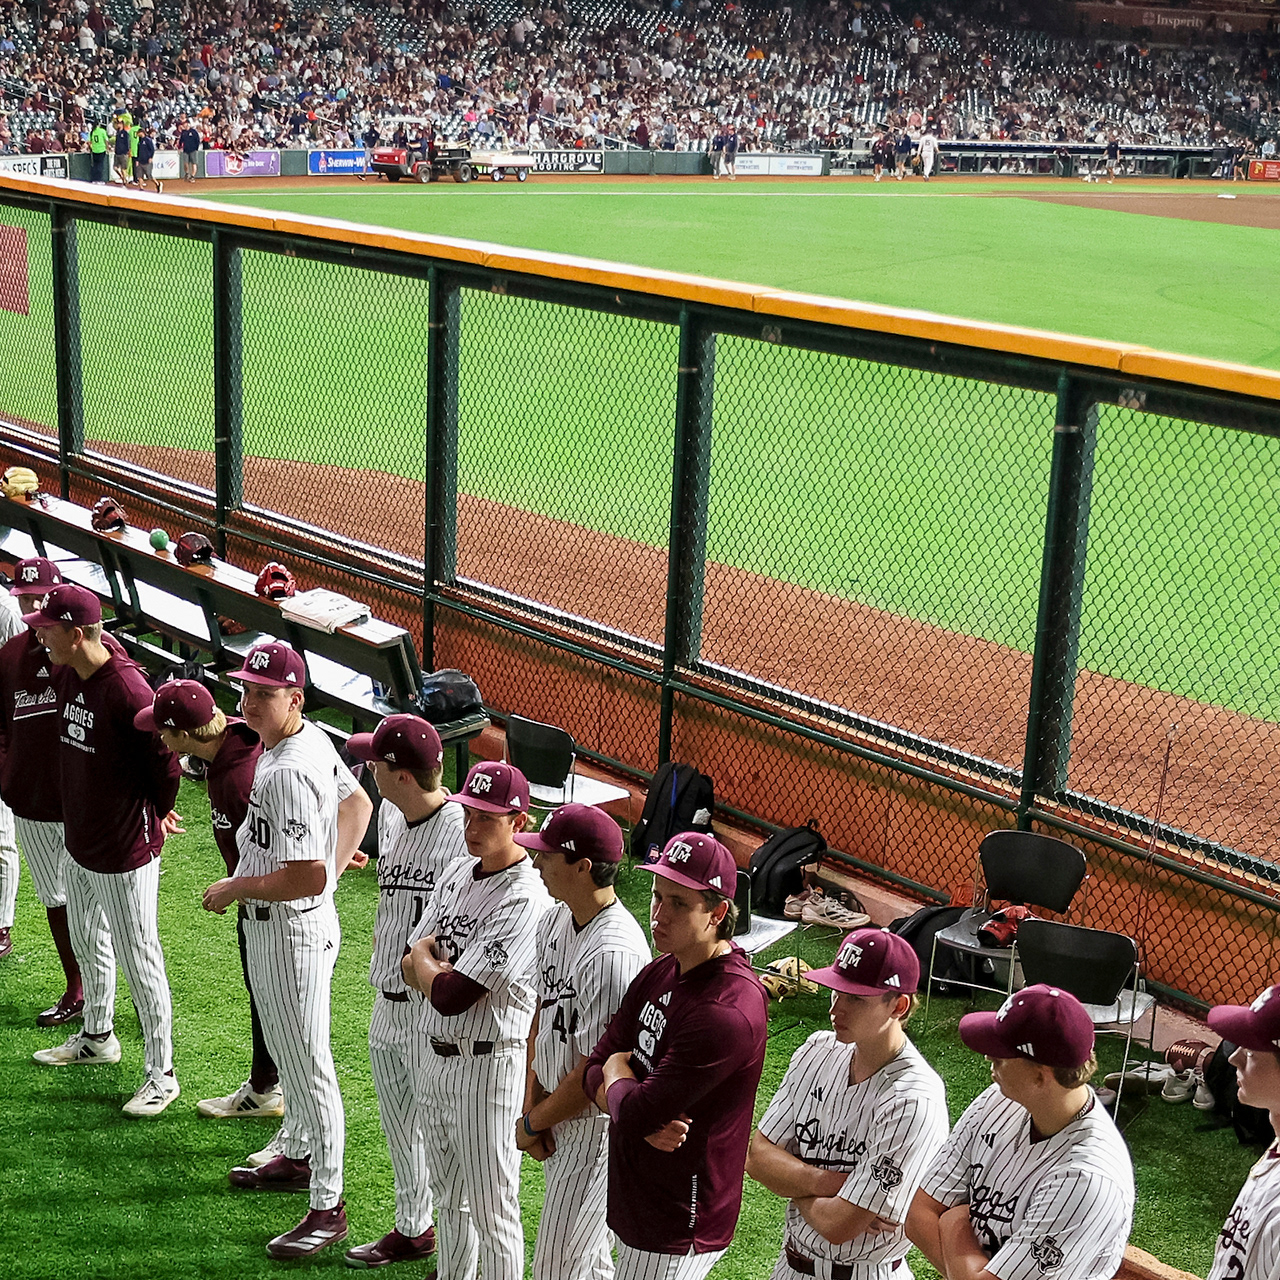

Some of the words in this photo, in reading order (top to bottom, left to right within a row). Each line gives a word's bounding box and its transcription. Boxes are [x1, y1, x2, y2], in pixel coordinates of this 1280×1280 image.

[533, 153, 602, 164] HARGROVE
[533, 163, 575, 172] ROOFING
[62, 702, 95, 730] AGGIES
